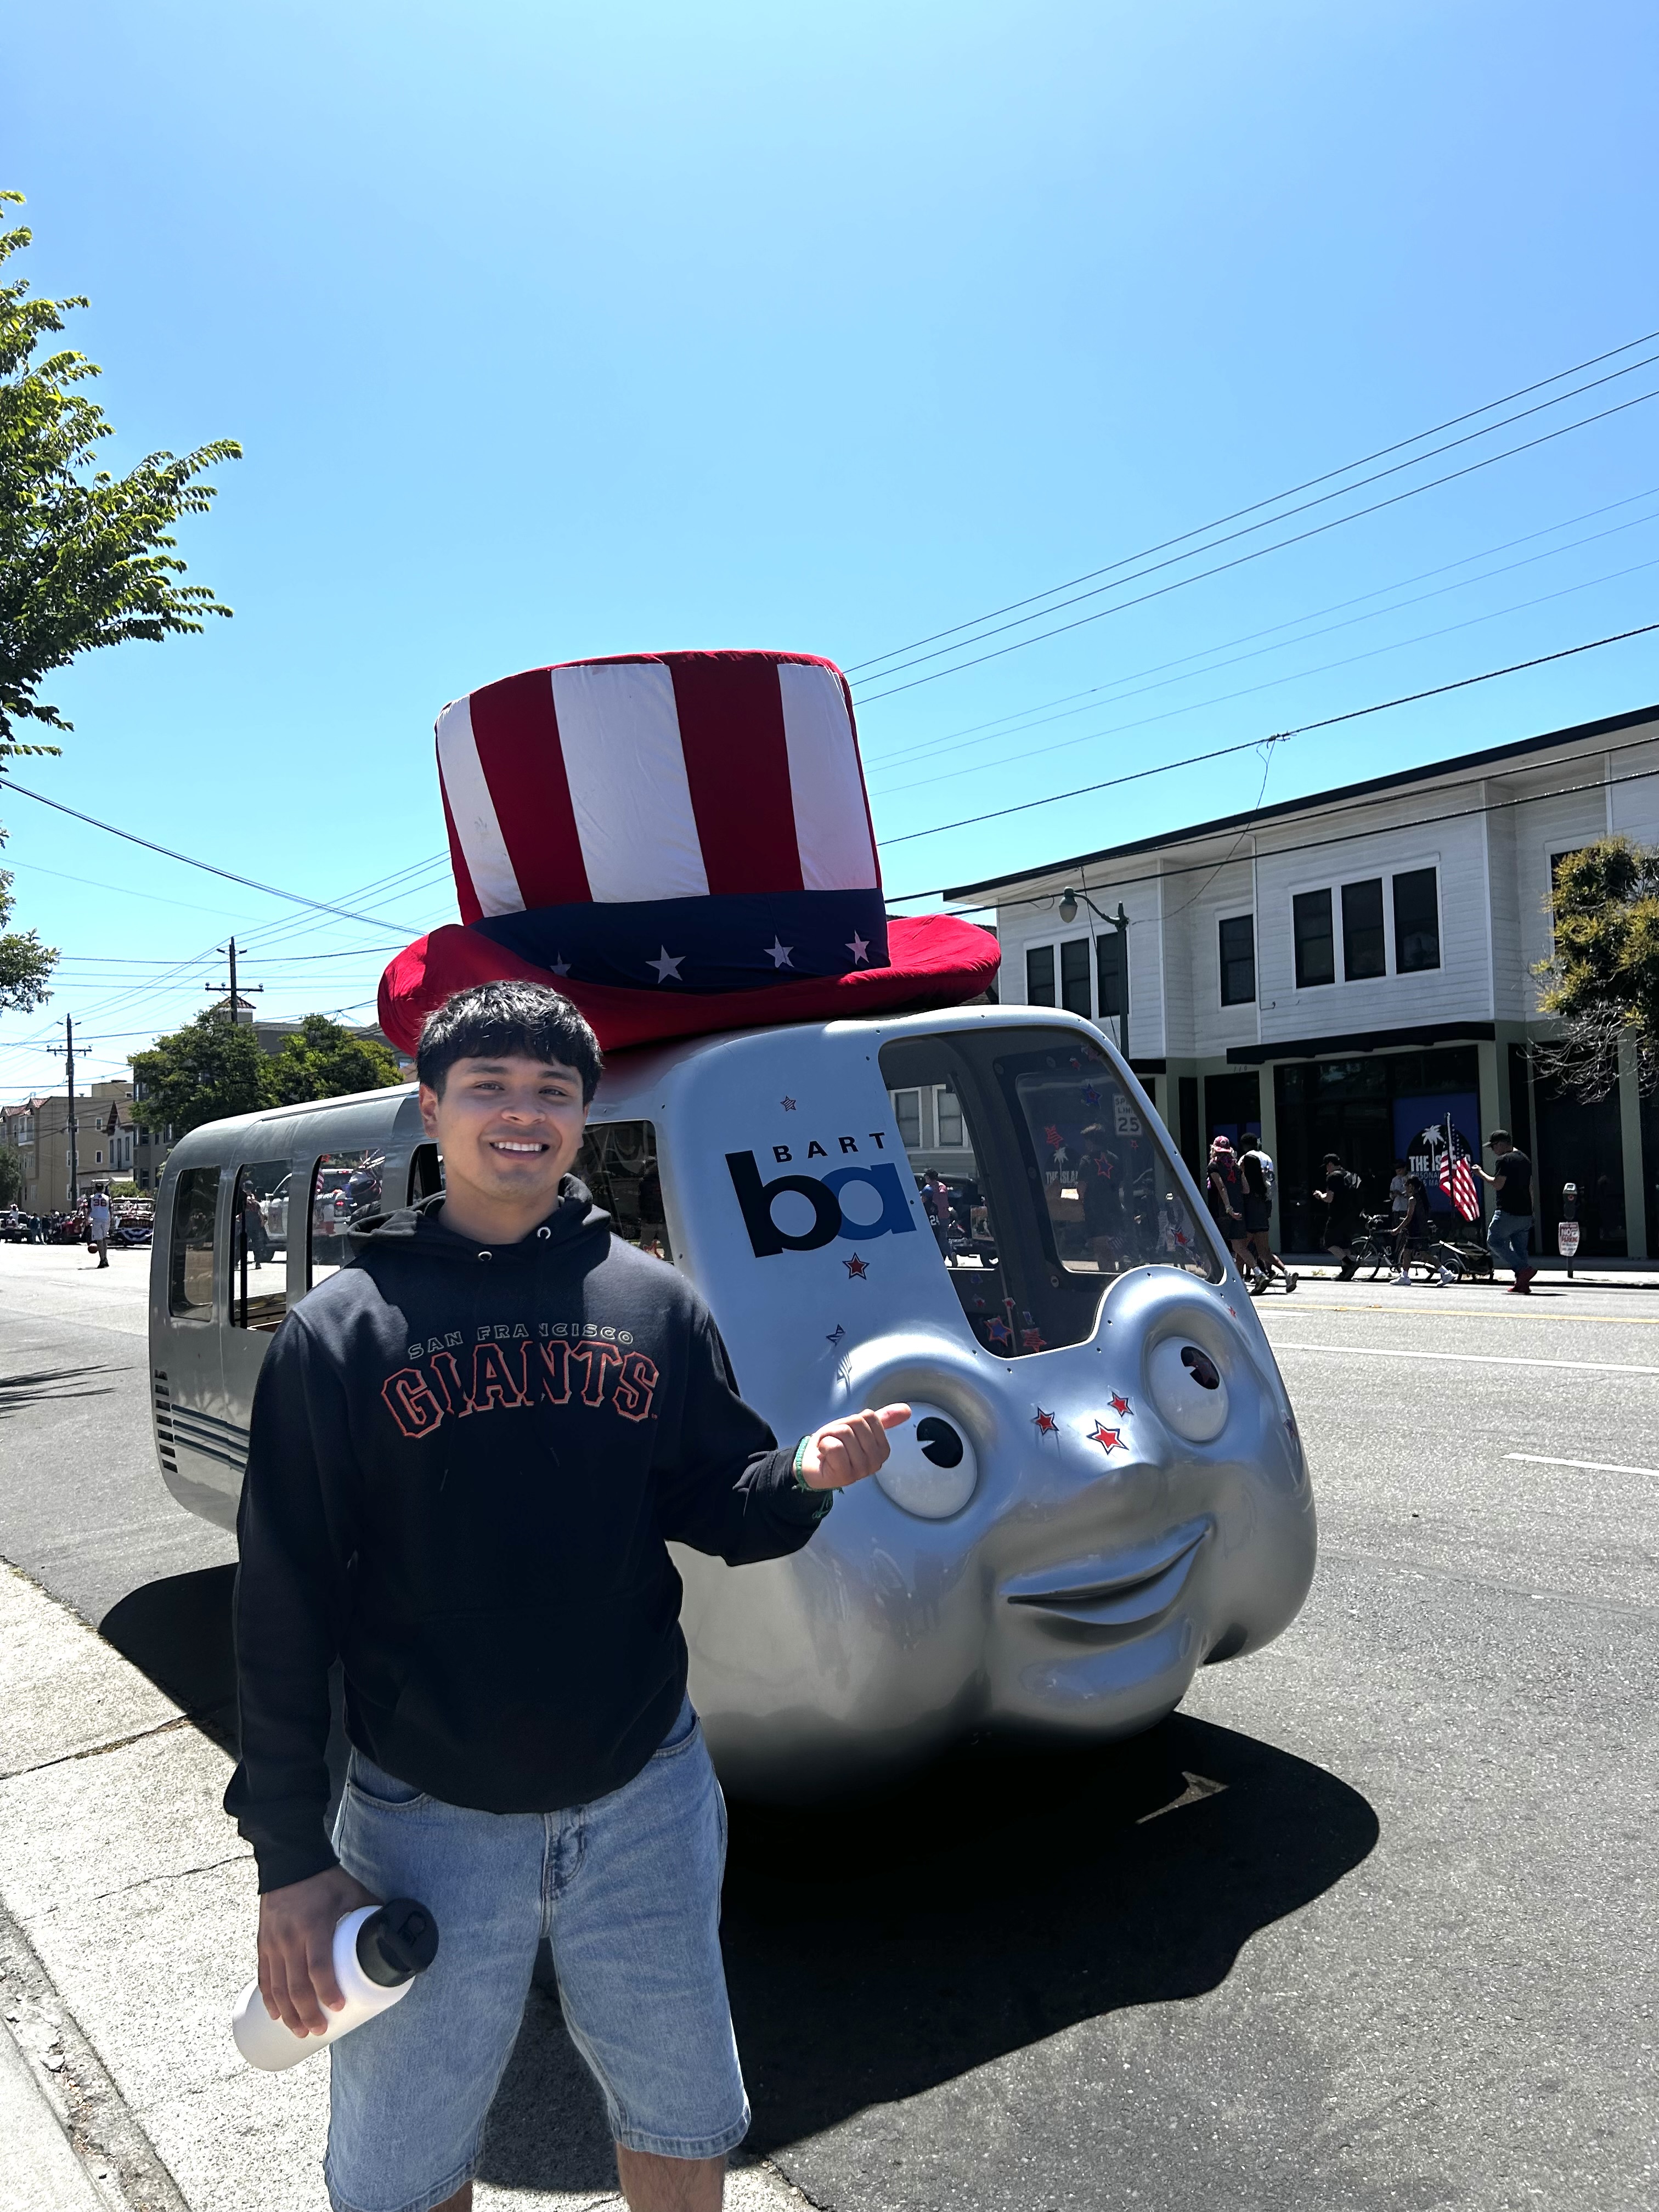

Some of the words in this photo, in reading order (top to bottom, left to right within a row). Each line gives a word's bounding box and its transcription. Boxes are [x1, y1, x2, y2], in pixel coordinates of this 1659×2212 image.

[1118, 1117, 1139, 1132] 25
[772, 1132, 885, 1163] BART
[1409, 1155, 1429, 1172] THE
[725, 1150, 917, 1258] ba
[408, 1330, 464, 1360] SAN
[477, 1323, 634, 1345] FRANCISCO
[381, 1340, 659, 1439] GIANTS
